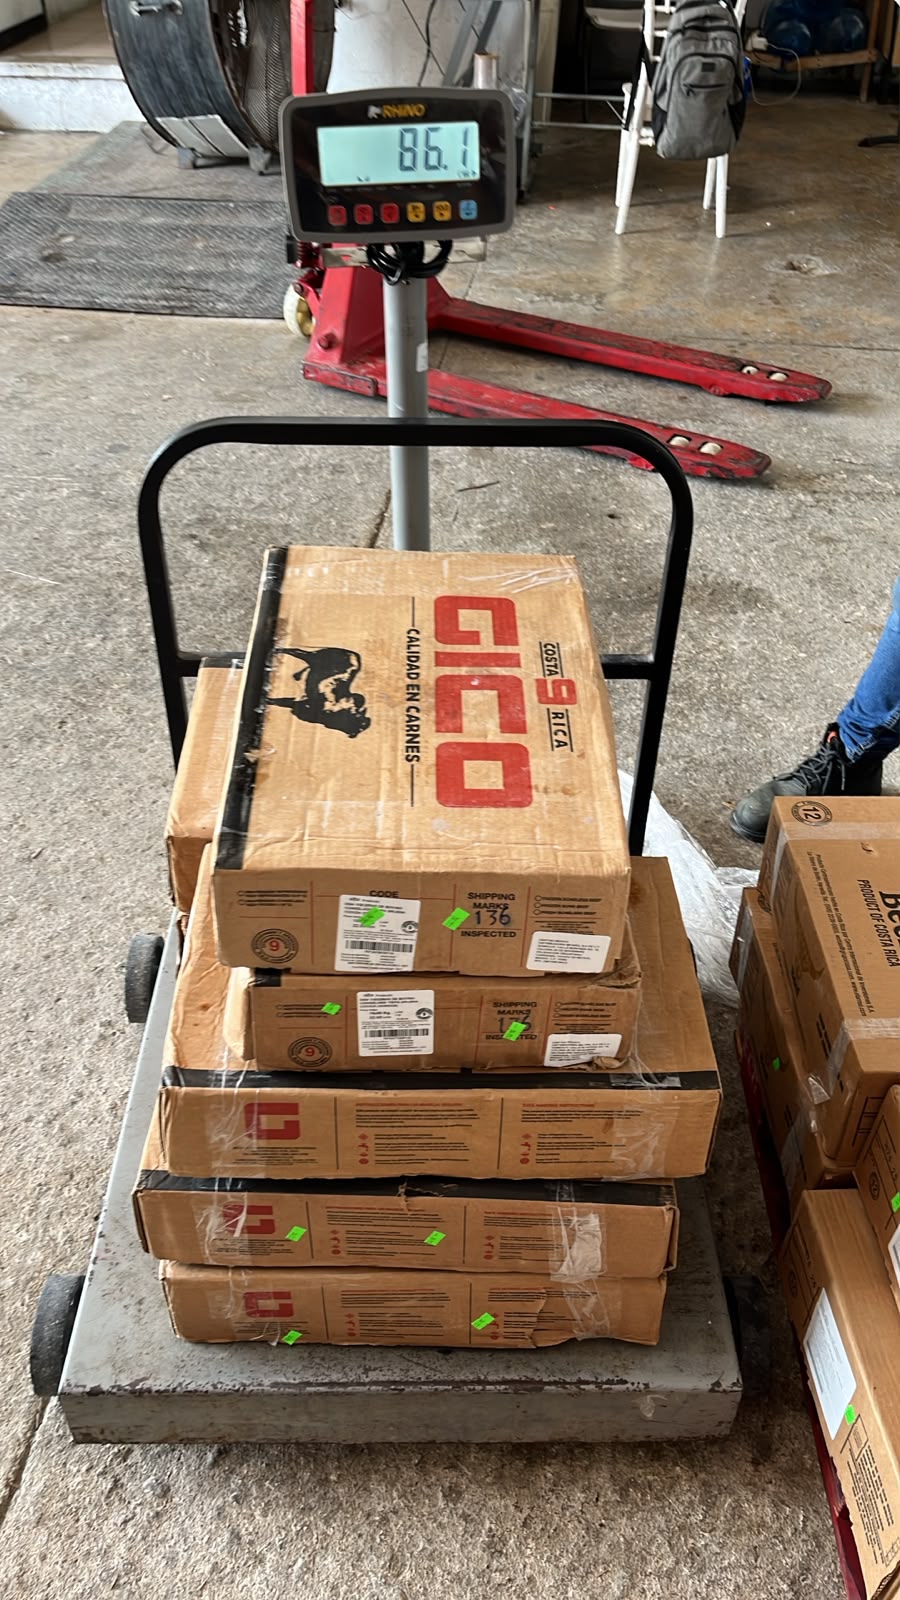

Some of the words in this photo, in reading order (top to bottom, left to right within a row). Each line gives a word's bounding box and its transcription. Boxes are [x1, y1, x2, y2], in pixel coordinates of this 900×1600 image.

[382, 104, 426, 118] RHINO
[399, 127, 468, 172] 86.1
[406, 628, 420, 680] CALIDAD
[406, 684, 420, 701] EN
[543, 642, 559, 677] COSTA
[551, 711, 569, 749] RICA
[434, 595, 534, 809] GICO
[405, 705, 420, 762] CARNES
[802, 806, 822, 820] 12
[369, 890, 399, 898] CODE
[467, 892, 516, 901] SHIPPING
[857, 880, 881, 912] PRODUCT
[472, 902, 509, 910] MARKS
[475, 907, 511, 926] 136
[870, 913, 885, 923] OF
[461, 930, 516, 938] INSPECTED
[874, 924, 895, 948] COSTA
[268, 937, 280, 951] 9
[883, 948, 900, 967] RICA
[304, 1047, 316, 1057] 9
[244, 1102, 301, 1140] G
